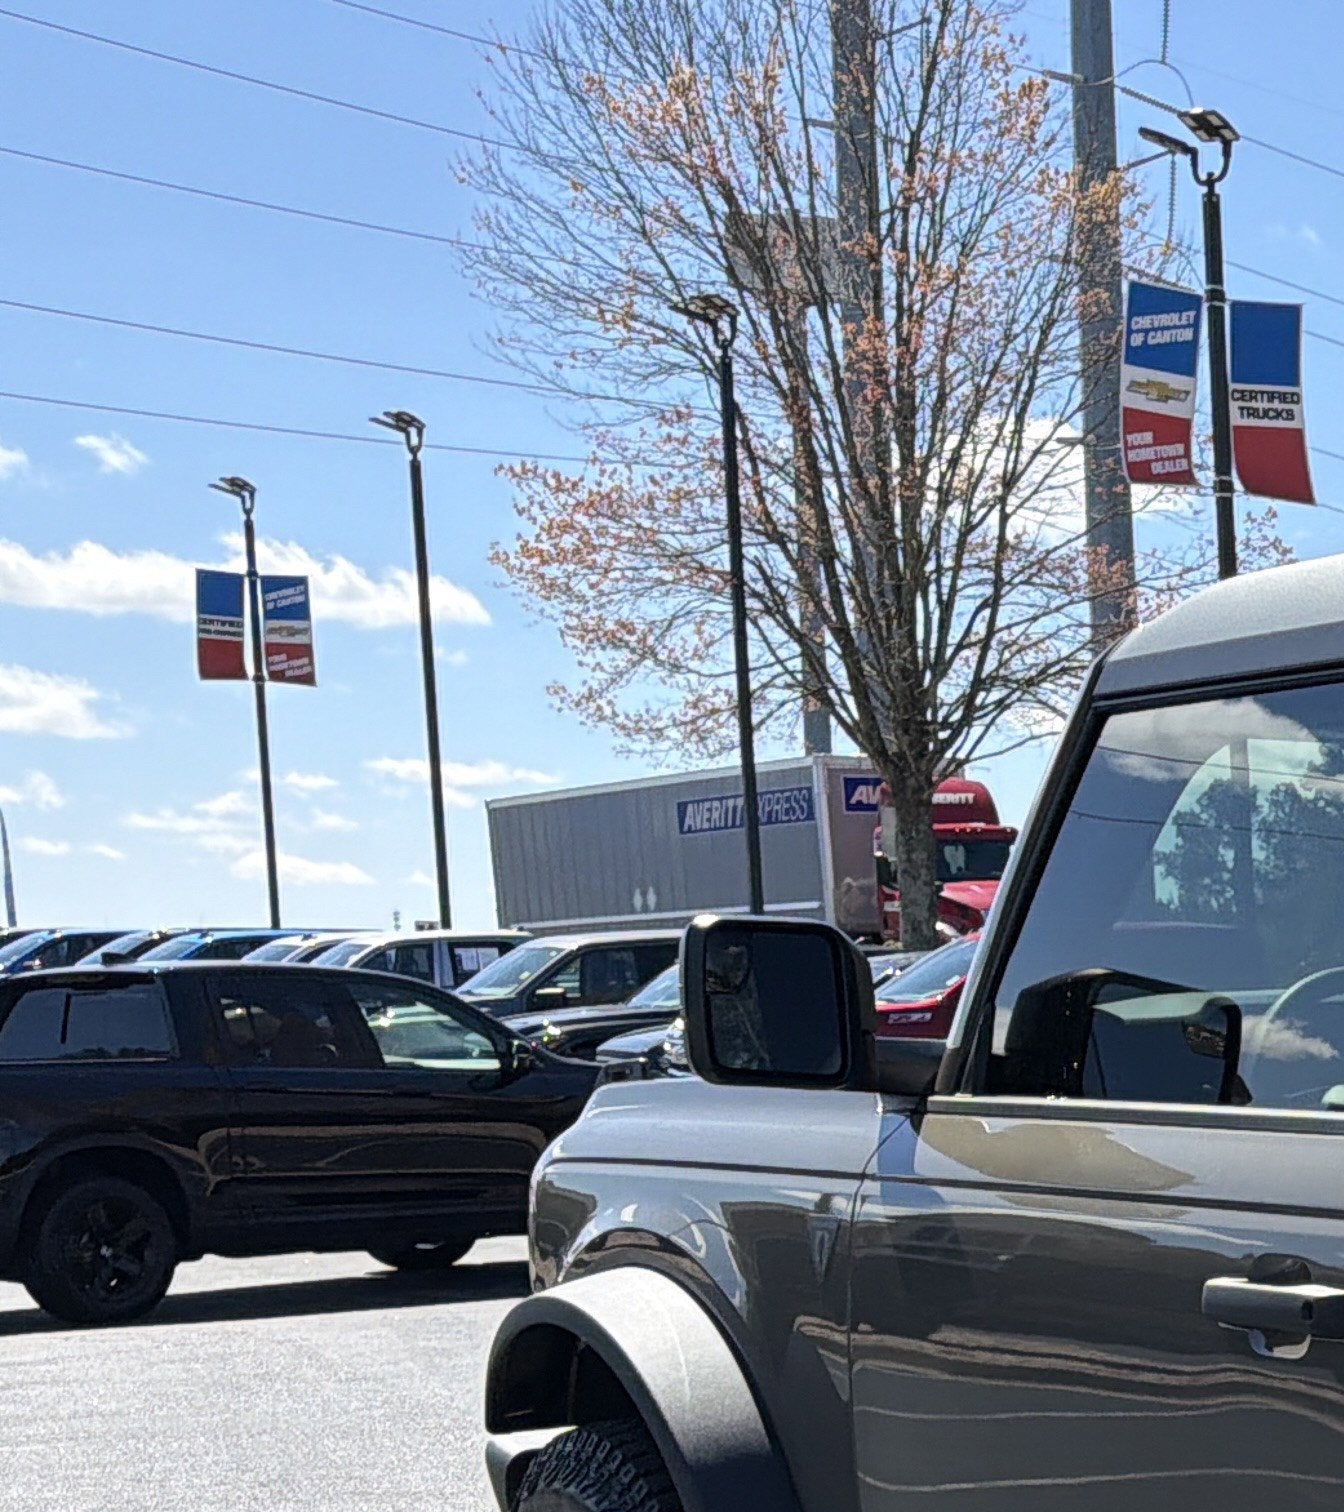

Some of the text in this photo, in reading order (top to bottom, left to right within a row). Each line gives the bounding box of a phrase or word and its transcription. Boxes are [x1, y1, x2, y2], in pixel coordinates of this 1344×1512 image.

[1131, 311, 1197, 330] CHEVROLET
[1130, 327, 1194, 347] OF CANTON
[1231, 389, 1300, 406] CERTIFIED
[1238, 407, 1295, 421] TRUCKS
[1151, 458, 1190, 476] DEALER
[683, 790, 808, 832] AVERITT XPRESS
